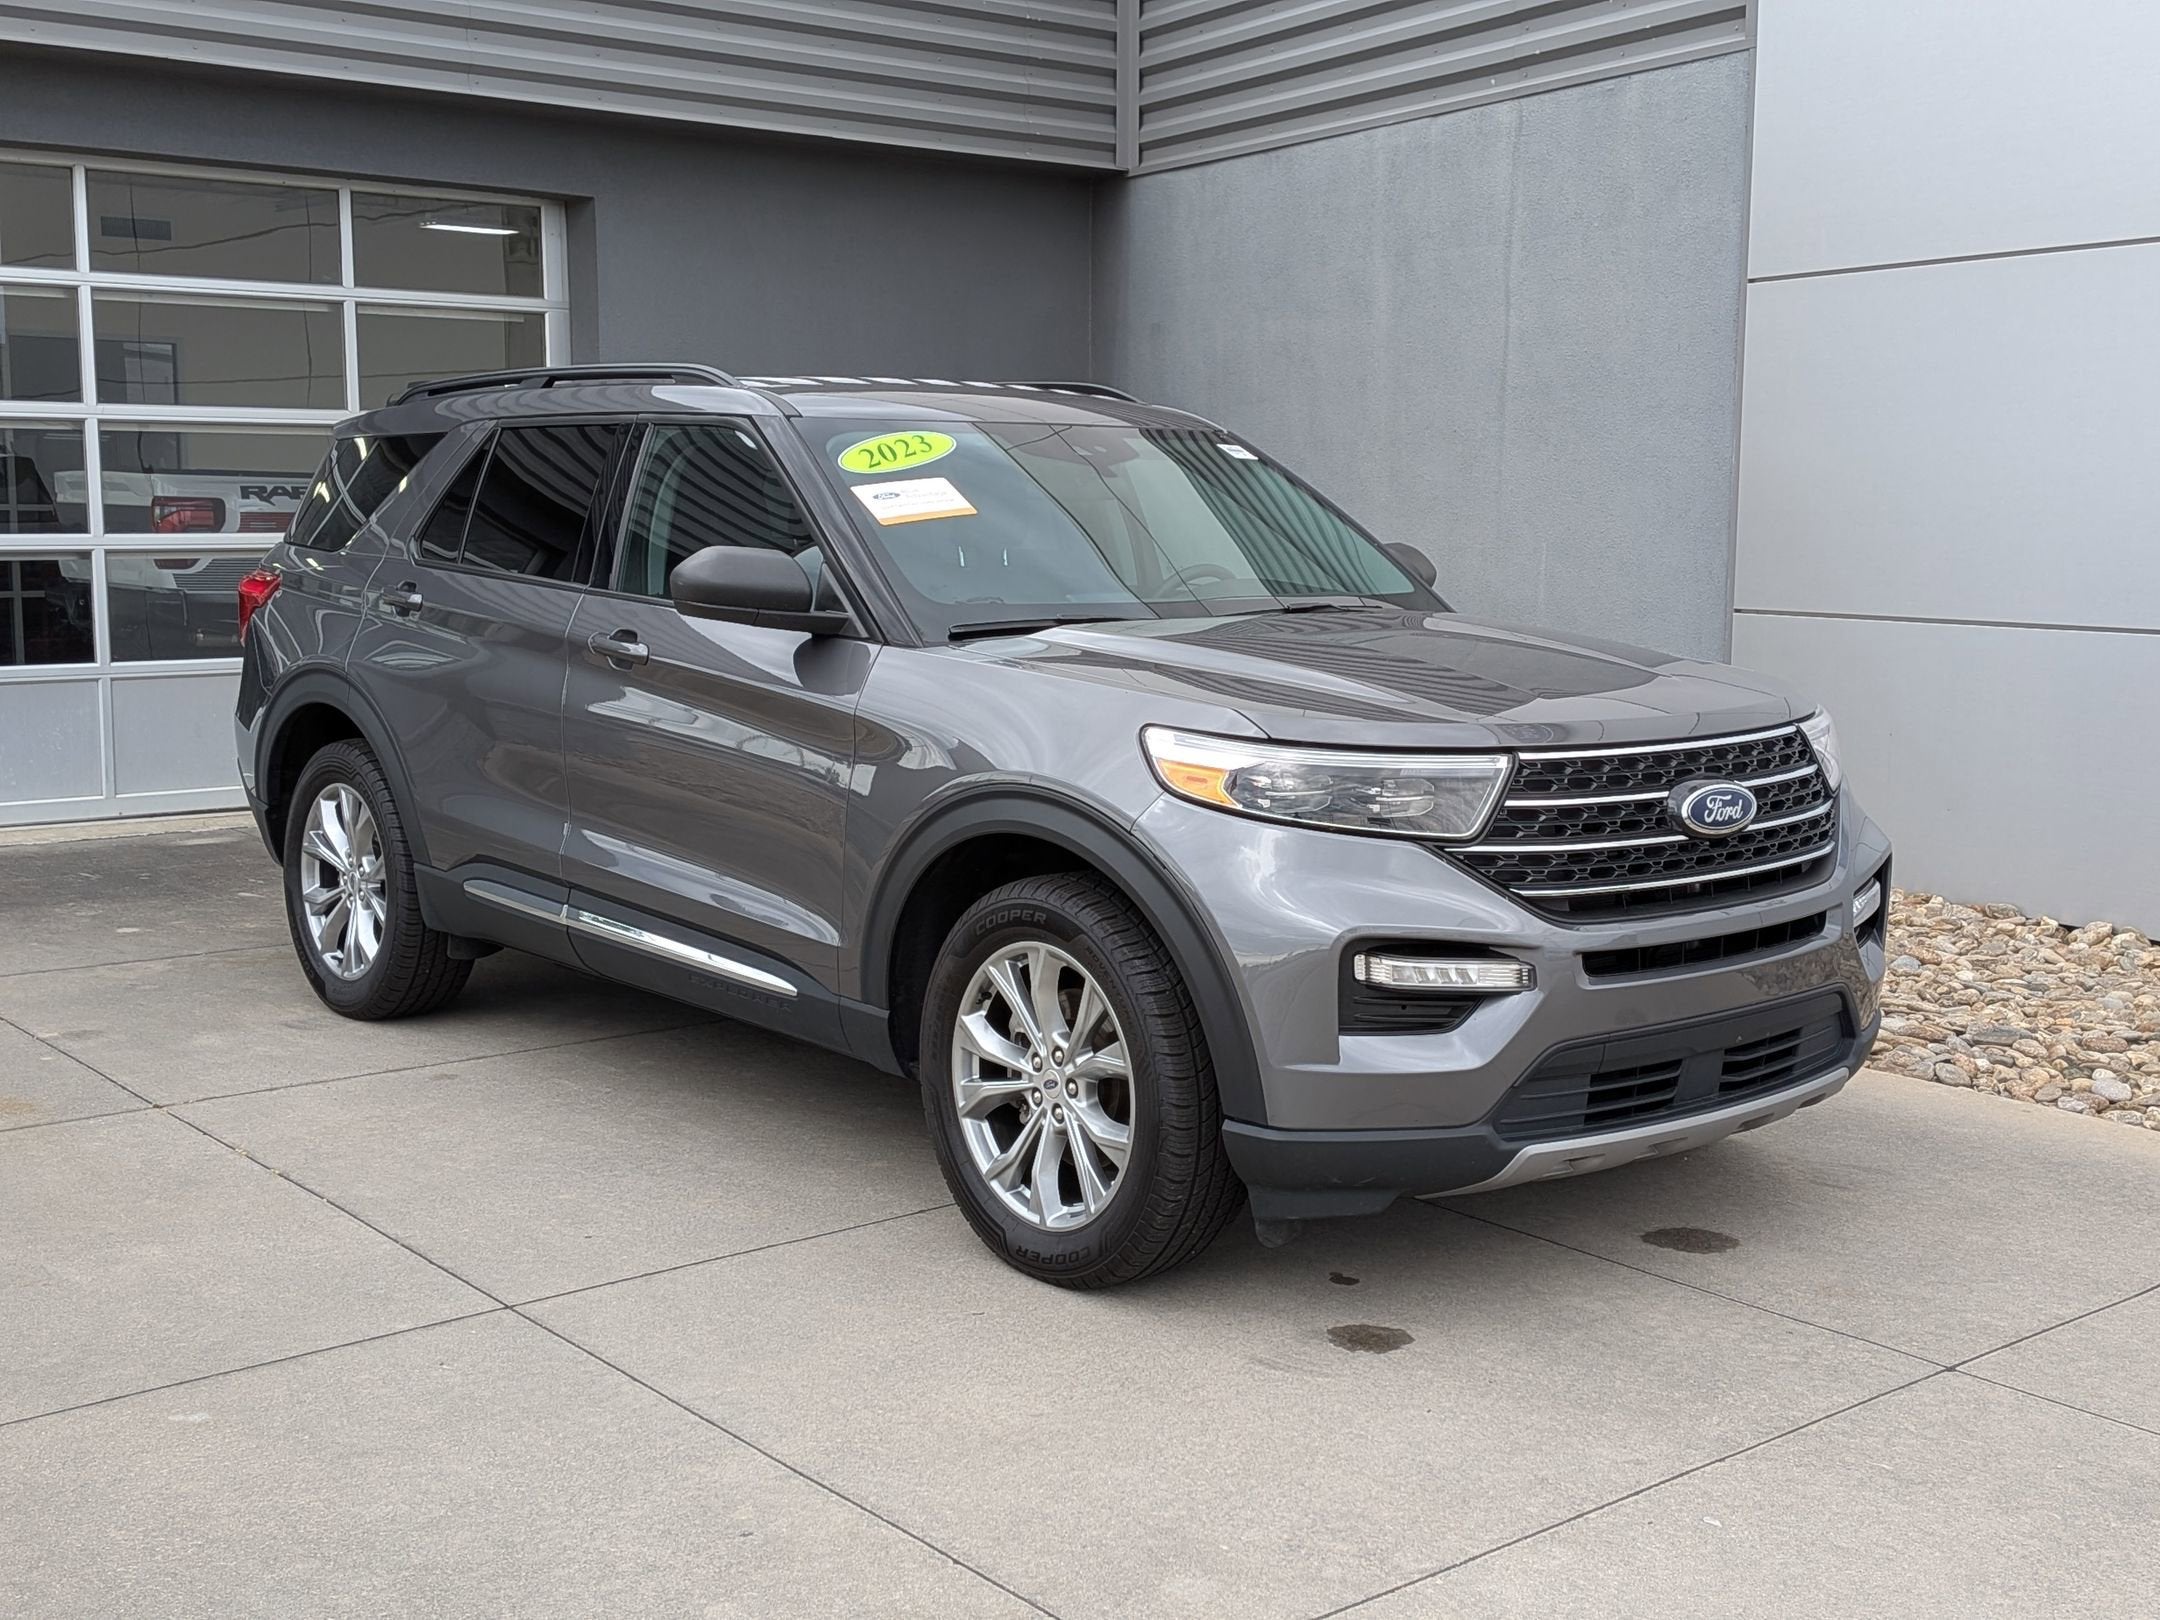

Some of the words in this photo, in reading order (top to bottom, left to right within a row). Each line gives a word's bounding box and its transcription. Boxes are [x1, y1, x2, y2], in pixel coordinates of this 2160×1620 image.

[858, 434, 933, 469] 2023
[1703, 794, 1744, 823] Ford
[975, 909, 1047, 936] COOPER
[1015, 1245, 1091, 1266] COOPER
